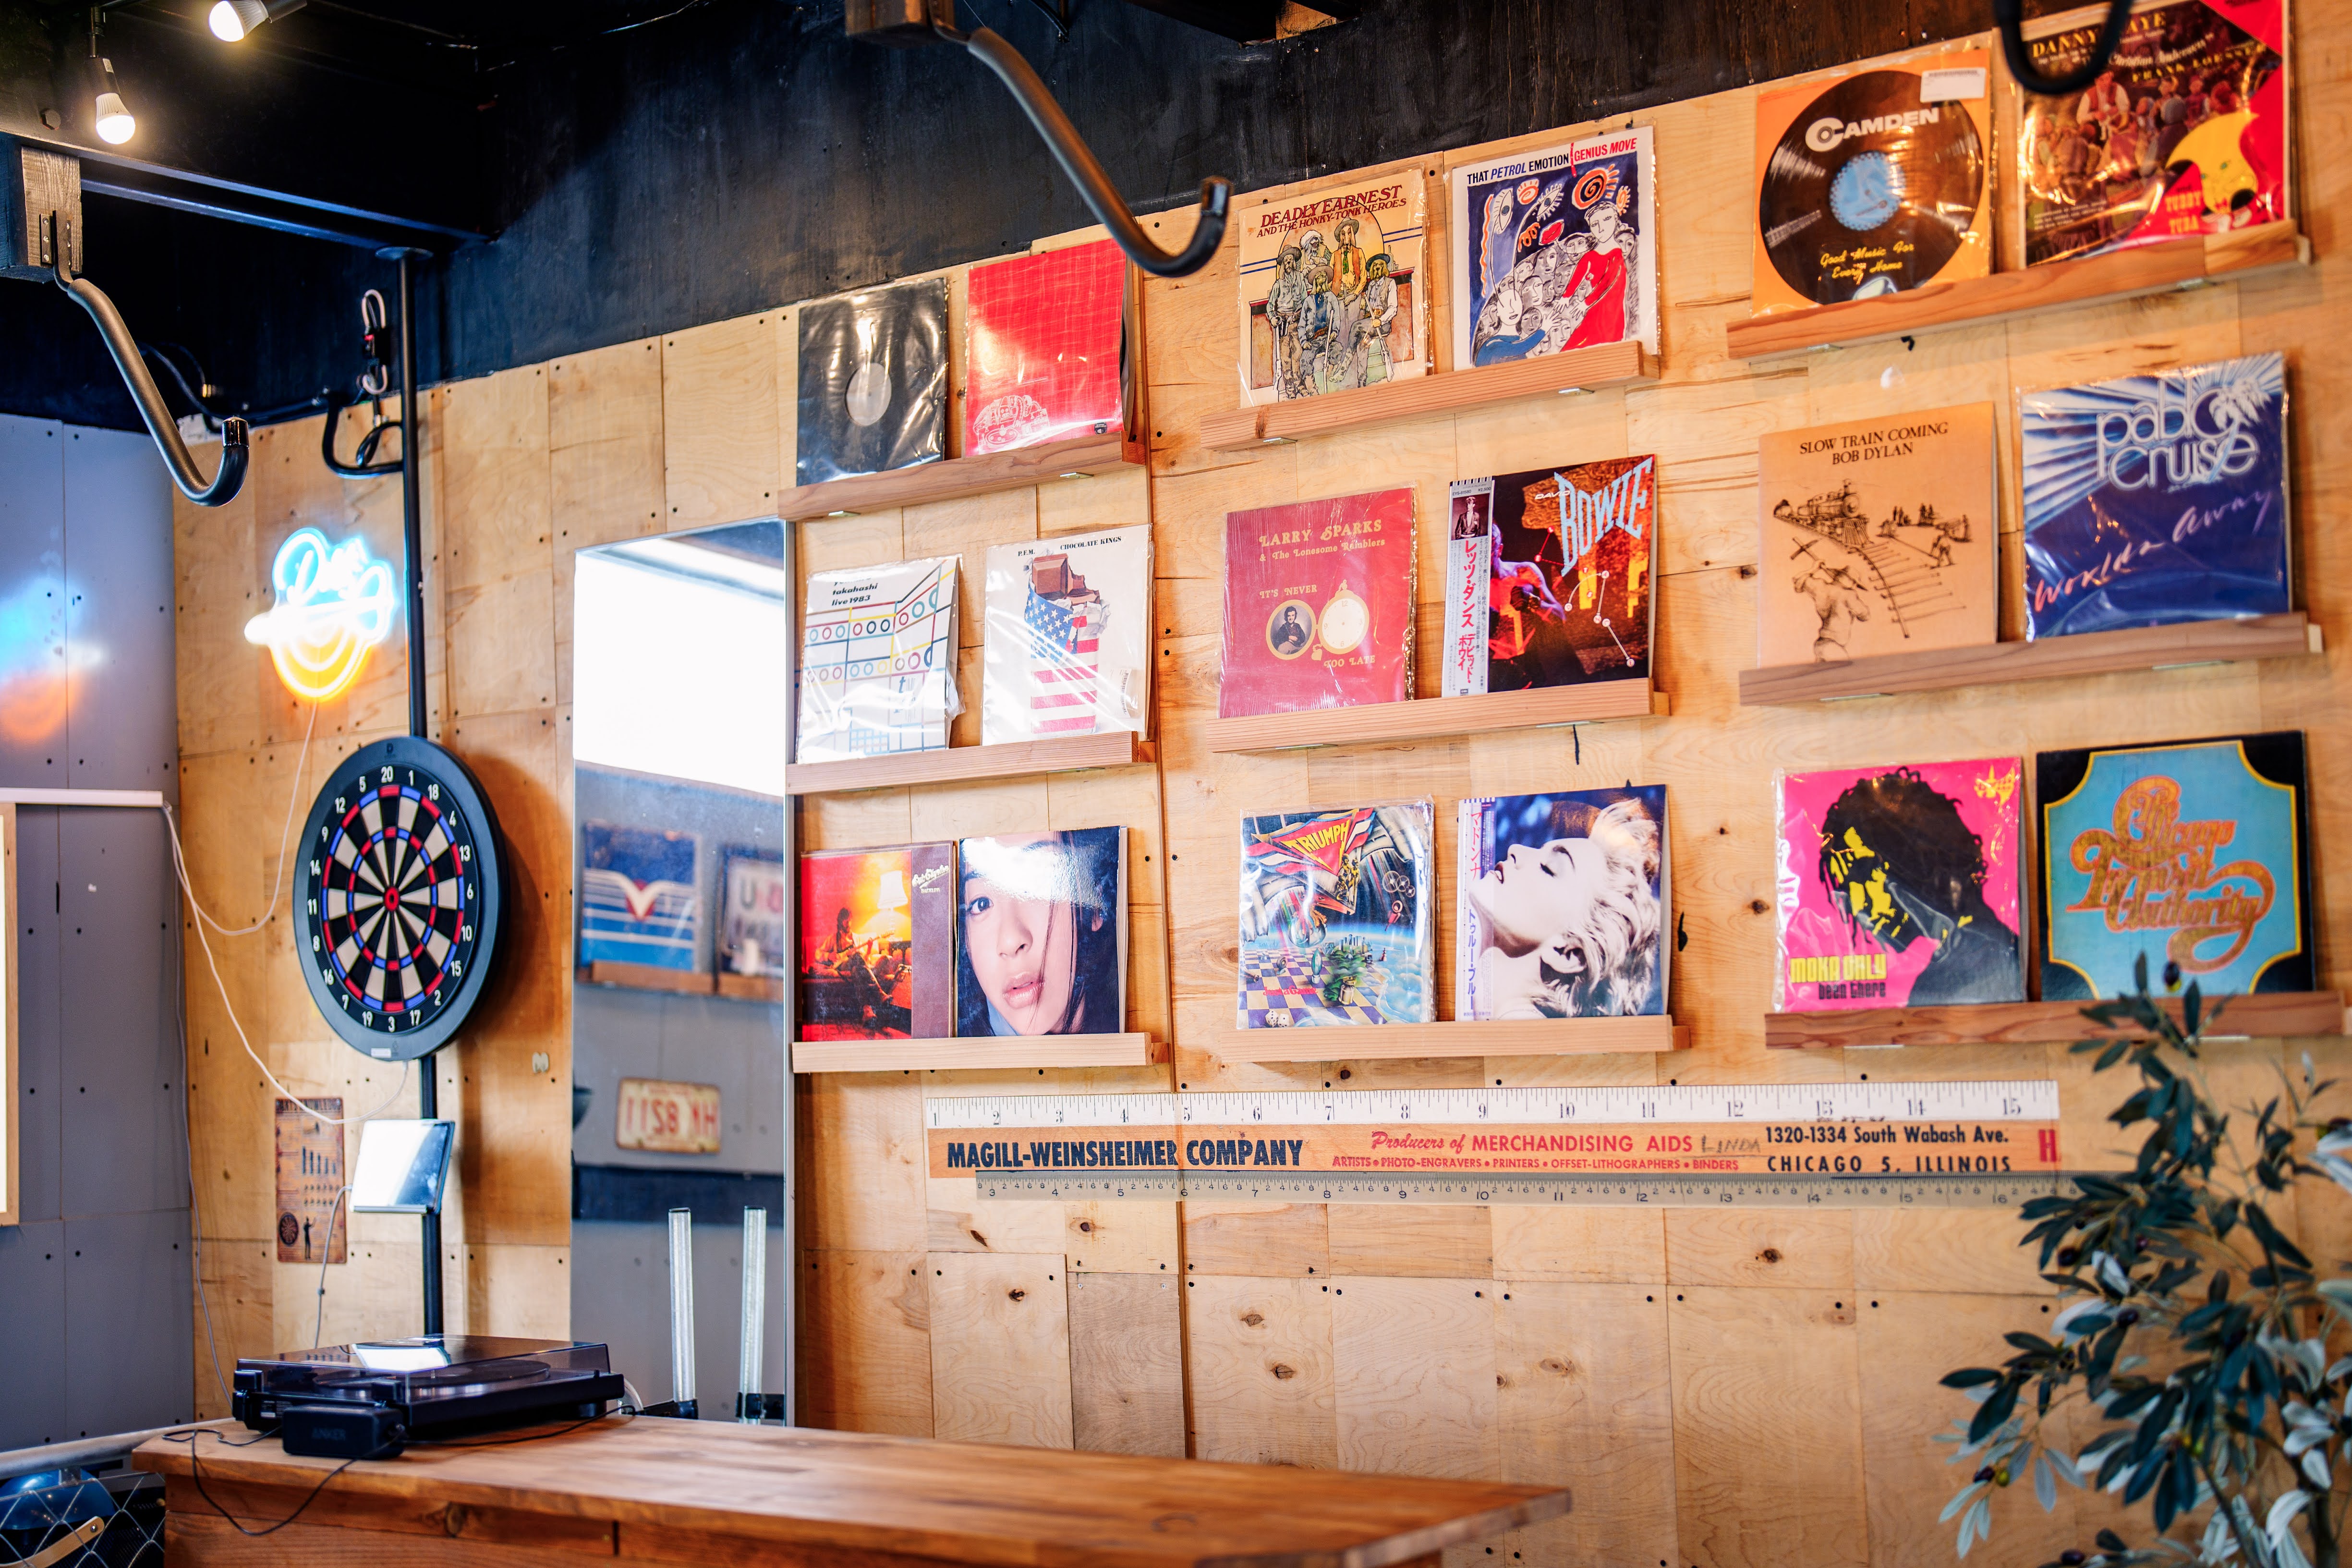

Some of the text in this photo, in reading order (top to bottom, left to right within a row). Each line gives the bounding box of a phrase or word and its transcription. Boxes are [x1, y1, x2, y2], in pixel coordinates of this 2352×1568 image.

[2033, 29, 2098, 58] DANNY
[2126, 11, 2166, 33] AYE
[1806, 107, 1940, 152] CAMDEN
[1467, 137, 1637, 185] THAT PETROL EMOTION GENIUS MOVE
[1261, 184, 1402, 228] DEADLY EARNEST
[1257, 198, 1407, 238] AND THE HONKY-TONK HEROES
[1820, 250, 1847, 268] Good
[1852, 246, 1887, 260] Music
[1831, 259, 1903, 285] Every Home
[1799, 422, 1949, 455] SLOW TRAIN COMING
[1832, 442, 1914, 465] BOB DYLAN
[1535, 490, 1571, 500] DAVID
[1554, 456, 1653, 577] BOWIE
[1259, 519, 1382, 547] LARRY SPARKS
[1060, 540, 1098, 550] CHOCOLATE
[1100, 536, 1122, 545] KINGS
[1260, 538, 1385, 562] & The Lonesome Ramblers
[832, 583, 878, 595] takahashi
[1260, 584, 1317, 599] IT'S NEVER
[1461, 540, 1477, 628] レッツ・ダンス
[849, 595, 871, 603] 1983
[1324, 655, 1376, 669] TOO LATE
[381, 766, 393, 782] 20
[409, 770, 414, 785] 1
[359, 776, 365, 792] 5
[428, 784, 439, 800] 18
[335, 798, 346, 813] 12
[449, 811, 457, 826] 4
[2112, 775, 2238, 860] Chicago
[322, 827, 328, 842] 9
[460, 845, 471, 861] 13
[1281, 819, 1350, 871] TRIUMPH
[1470, 812, 1482, 881] マドンナ
[310, 860, 321, 875] 14
[467, 884, 473, 899] 6
[308, 899, 317, 915] 11
[461, 925, 472, 941] 10
[313, 936, 320, 950] 8
[1468, 909, 1476, 1010] トゥルー・ブルー
[450, 961, 461, 976] 15
[324, 969, 334, 985] 16
[342, 995, 349, 1009] 7
[434, 990, 441, 1006] 2
[363, 1011, 373, 1027] 19
[388, 1016, 395, 1032] 3
[410, 1009, 421, 1025] 17
[993, 1111, 999, 1125] 2
[1056, 1109, 1063, 1123] 3
[1120, 1108, 1128, 1123] 4
[1184, 1106, 1190, 1122] 5
[1253, 1106, 1260, 1121] 6
[1325, 1106, 1332, 1121] 7
[1401, 1104, 1408, 1120] 8
[1479, 1103, 1486, 1119] 9
[1559, 1102, 1575, 1118] 10
[1642, 1102, 1655, 1118] 11
[1726, 1101, 1744, 1118] 12
[1816, 1099, 1833, 1116] 13
[1907, 1098, 1926, 1116] 14
[2003, 1098, 2022, 1115] 15
[1371, 1130, 1693, 1154] Producers of MERCHANDISING AIDS
[1766, 1125, 2009, 1143] 1320-1334 South Wabash Ave.
[947, 1140, 1303, 1168] MAGILL-WEINSHEIMER COMPANY
[1333, 1156, 1739, 1171] ARTISTS PHOTO-ENGRAVERS PRINTERS OFFSET-LITHOGRAPHERS BINDERS
[1768, 1155, 1862, 1172] CHICAGO
[1916, 1155, 2011, 1172] ILLINOIS
[1323, 1190, 1331, 1199] 8
[1399, 1191, 1406, 1199] 9
[1476, 1191, 1489, 1200] 10
[1554, 1192, 1563, 1201] 11
[1637, 1193, 1649, 1202] 12
[1720, 1193, 1733, 1202] 13
[1807, 1194, 1820, 1203] 14
[1900, 1193, 1913, 1203] 15
[1993, 1193, 2008, 1203] 16
